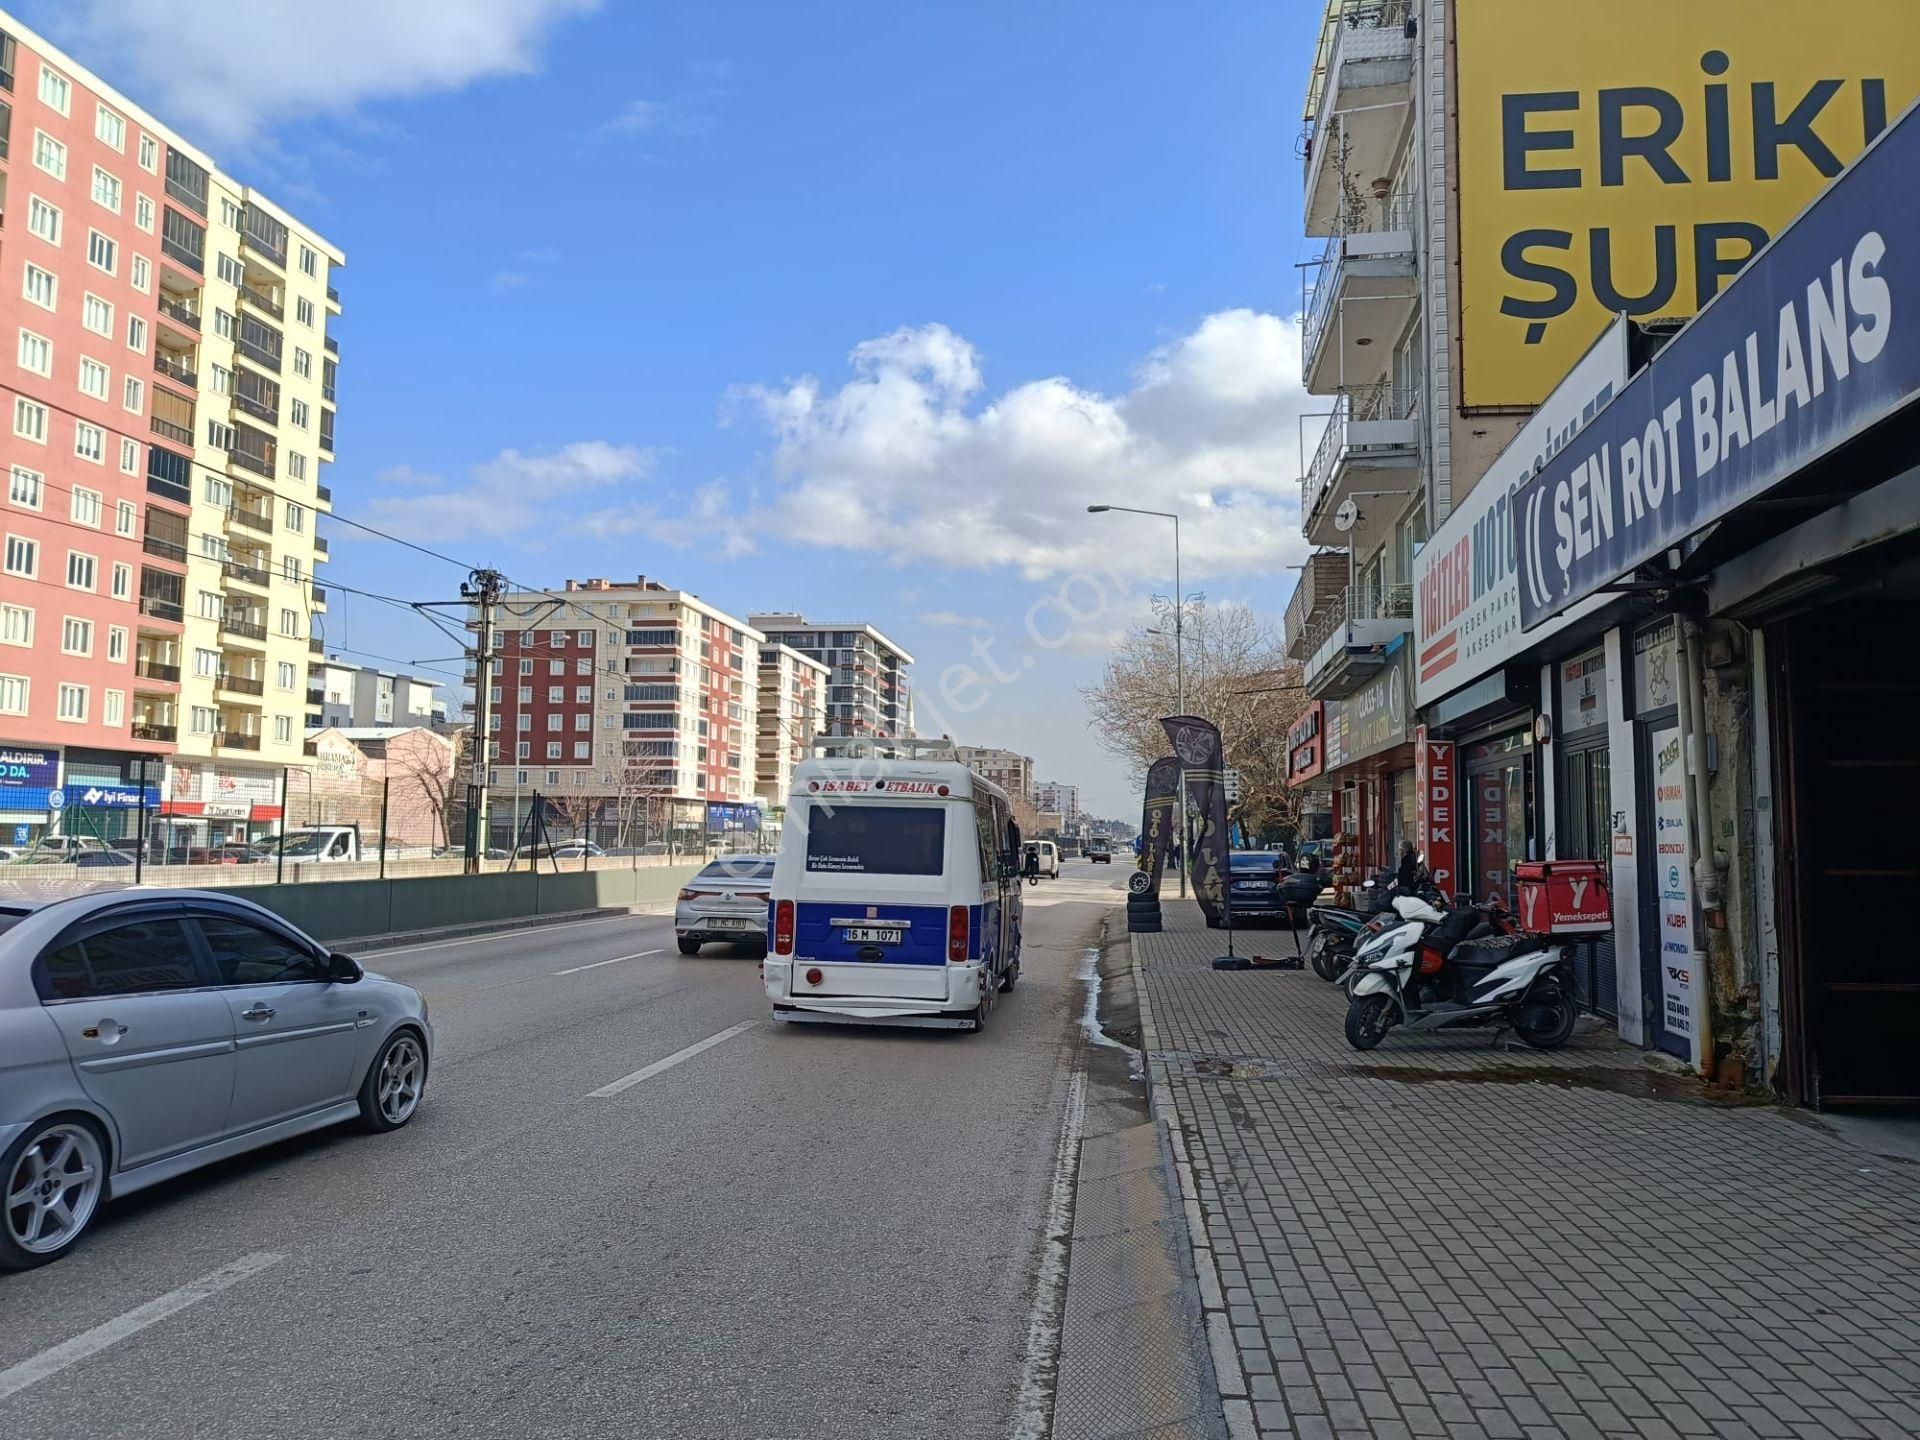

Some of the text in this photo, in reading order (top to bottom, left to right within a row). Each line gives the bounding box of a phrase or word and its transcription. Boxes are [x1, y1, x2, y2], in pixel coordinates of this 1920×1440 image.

[1553, 433, 1614, 596] ŞEN
[1620, 397, 1682, 528] ROT
[1691, 231, 1891, 478] BALANS
[1459, 586, 1516, 639] YEDEK PARÇ
[1466, 614, 1517, 659] AKSESUAR
[822, 781, 872, 792] İSABEY
[1432, 745, 1451, 843] YEDEK
[1663, 784, 1682, 800] YAMAH
[1149, 809, 1162, 837] OTO
[1665, 818, 1683, 828] BAJA
[1553, 910, 1608, 922] Yemeksepeti
[847, 929, 899, 941] 16 M 1071
